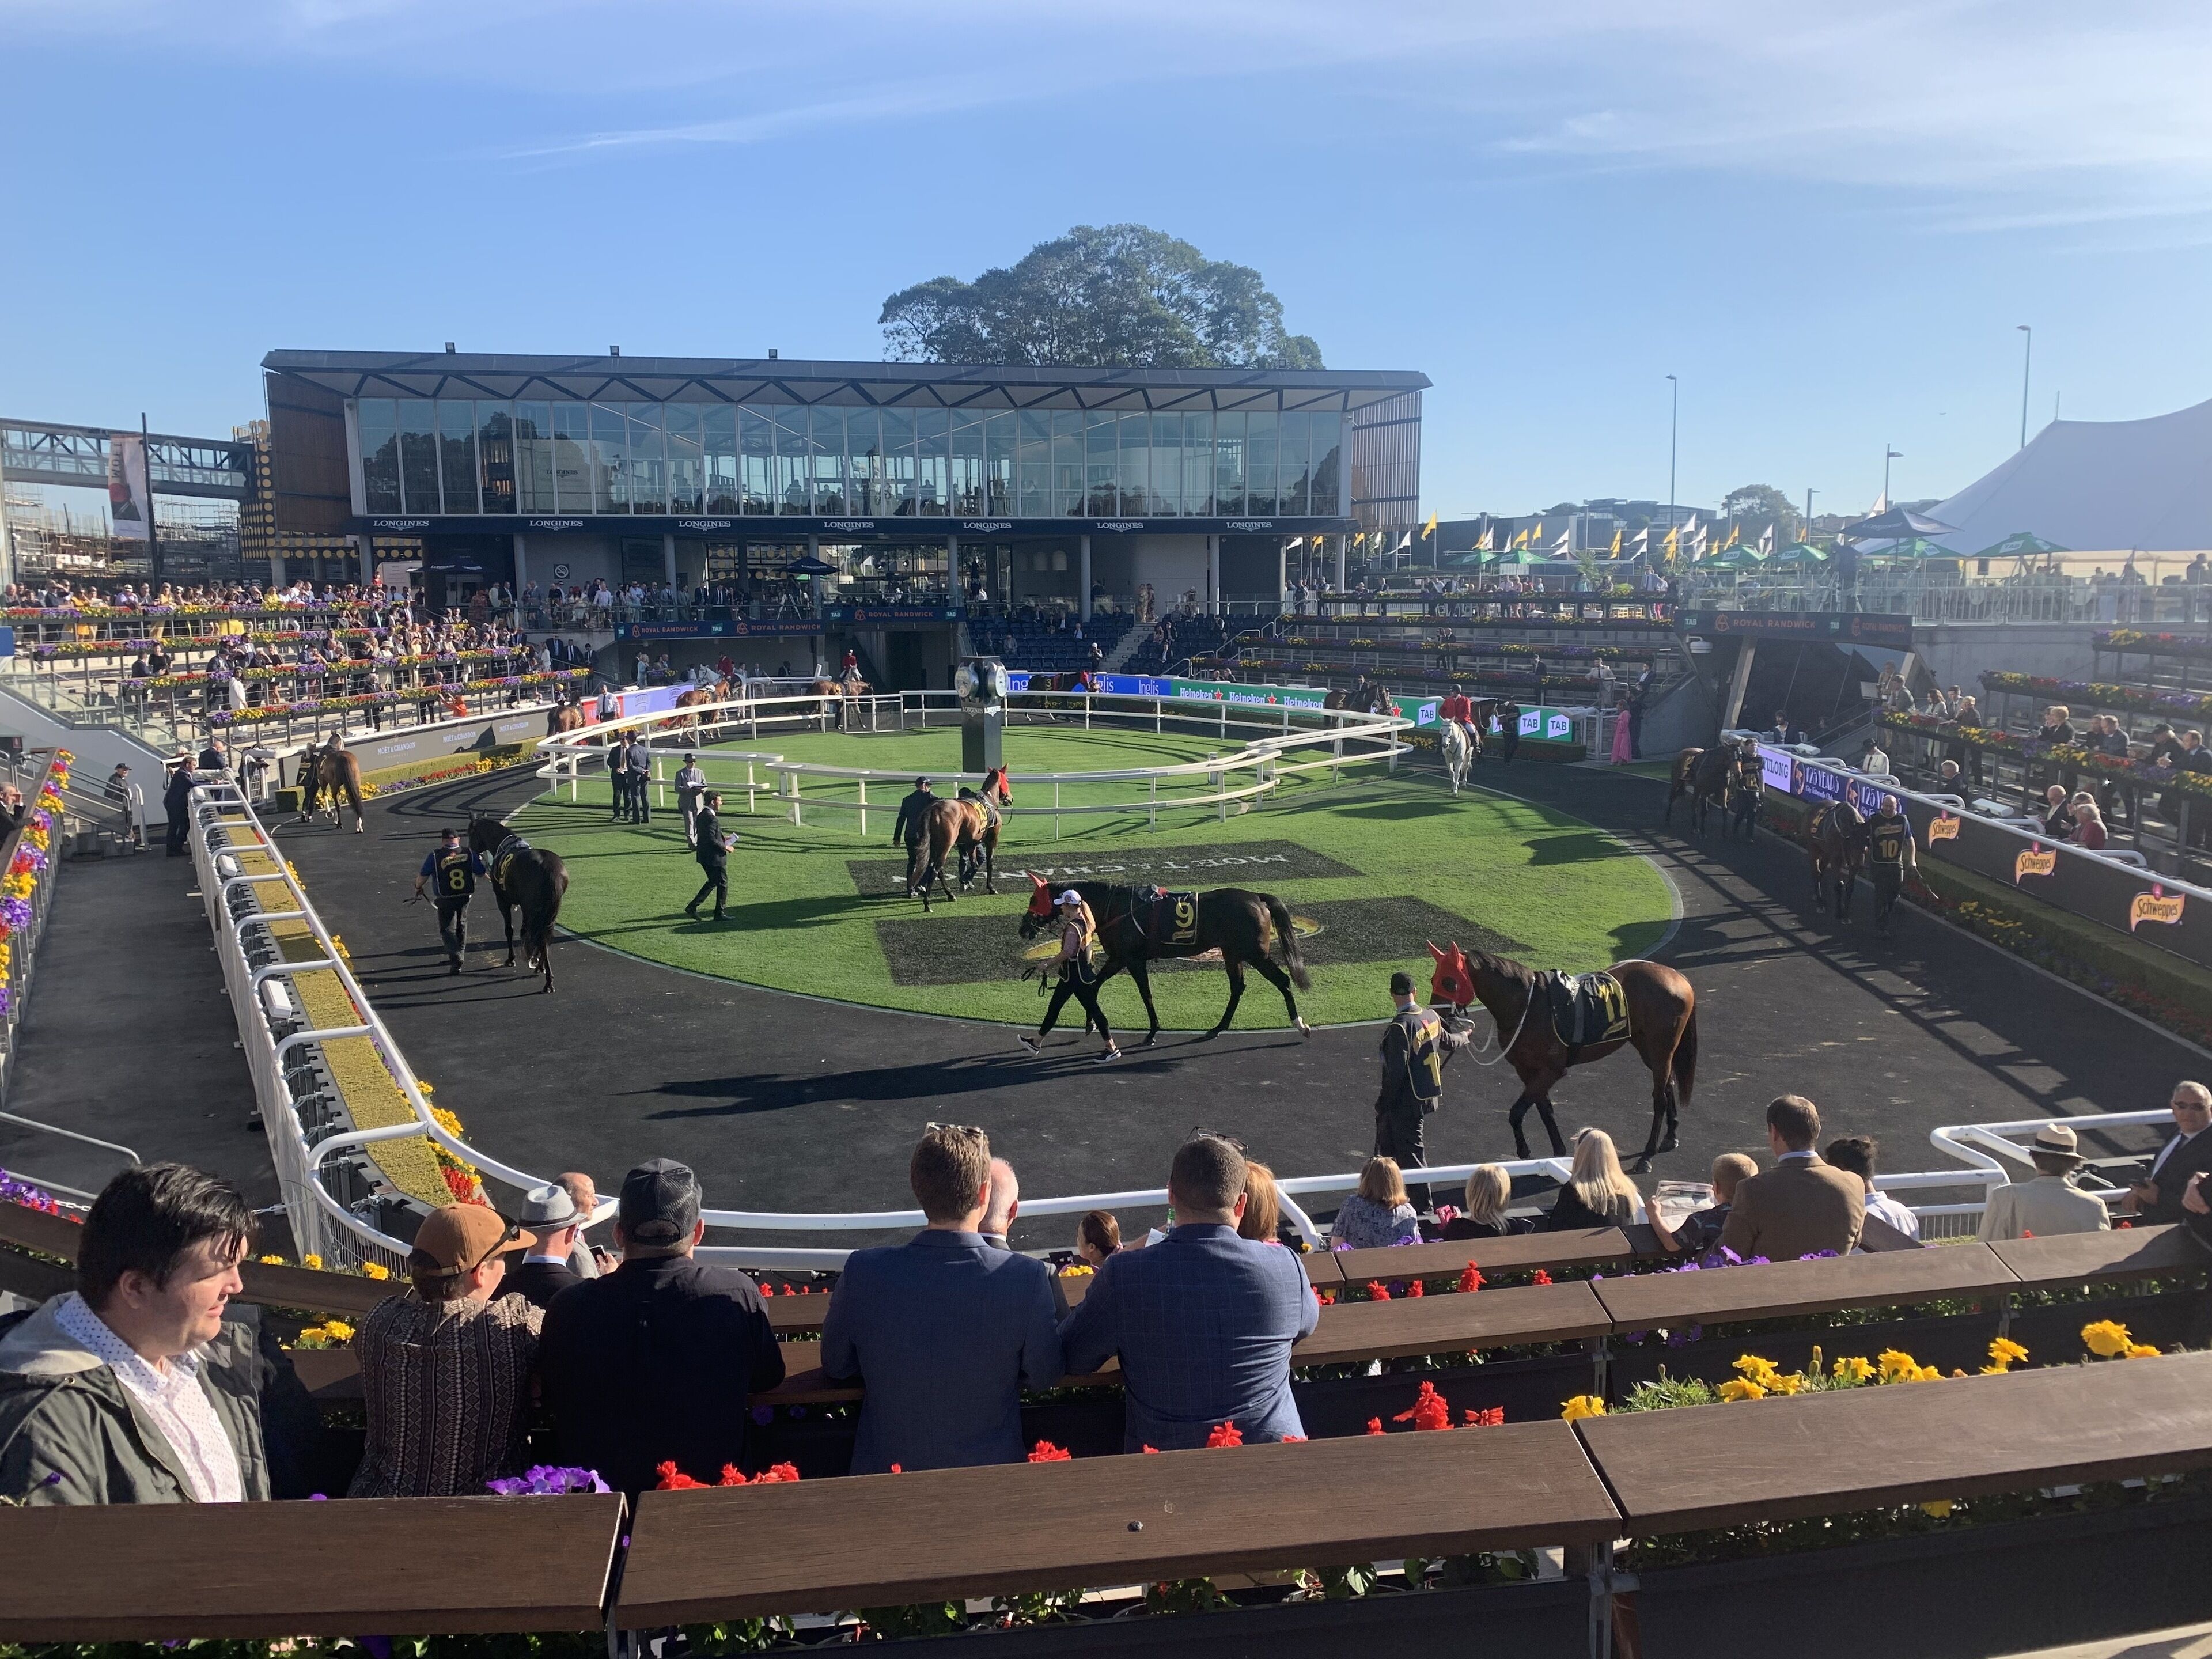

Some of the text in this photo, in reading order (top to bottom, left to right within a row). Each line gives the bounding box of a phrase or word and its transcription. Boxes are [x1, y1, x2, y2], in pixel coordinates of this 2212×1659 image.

[1733, 619, 1816, 628] ROYAL RANDWICK
[1007, 675, 1032, 691] Ing
[1046, 679, 1052, 687] 3
[1098, 676, 1114, 692] glis
[1138, 680, 1159, 696] Inglis
[1180, 687, 1213, 699] Heineken
[1229, 691, 1266, 703] Heineken
[1338, 694, 1346, 704] 2
[1283, 696, 1323, 709] Heineken
[1421, 709, 1434, 719] TAB
[1522, 718, 1538, 728] TAB
[1550, 720, 1567, 730] TAB
[457, 731, 476, 740] CHANDON
[393, 742, 416, 752] CHANDON
[298, 771, 308, 783] 7
[1806, 767, 1818, 785] 125
[1862, 786, 1902, 813] 125 YES
[1932, 822, 1956, 837] Schweppes
[1879, 840, 1899, 858] 10
[2020, 855, 2052, 872] Schweppes
[449, 869, 465, 890] 8
[1176, 902, 1194, 928] 9
[2137, 898, 2179, 920] Schweppes
[1599, 981, 1626, 1023] 11
[1423, 1052, 1441, 1087] 1
